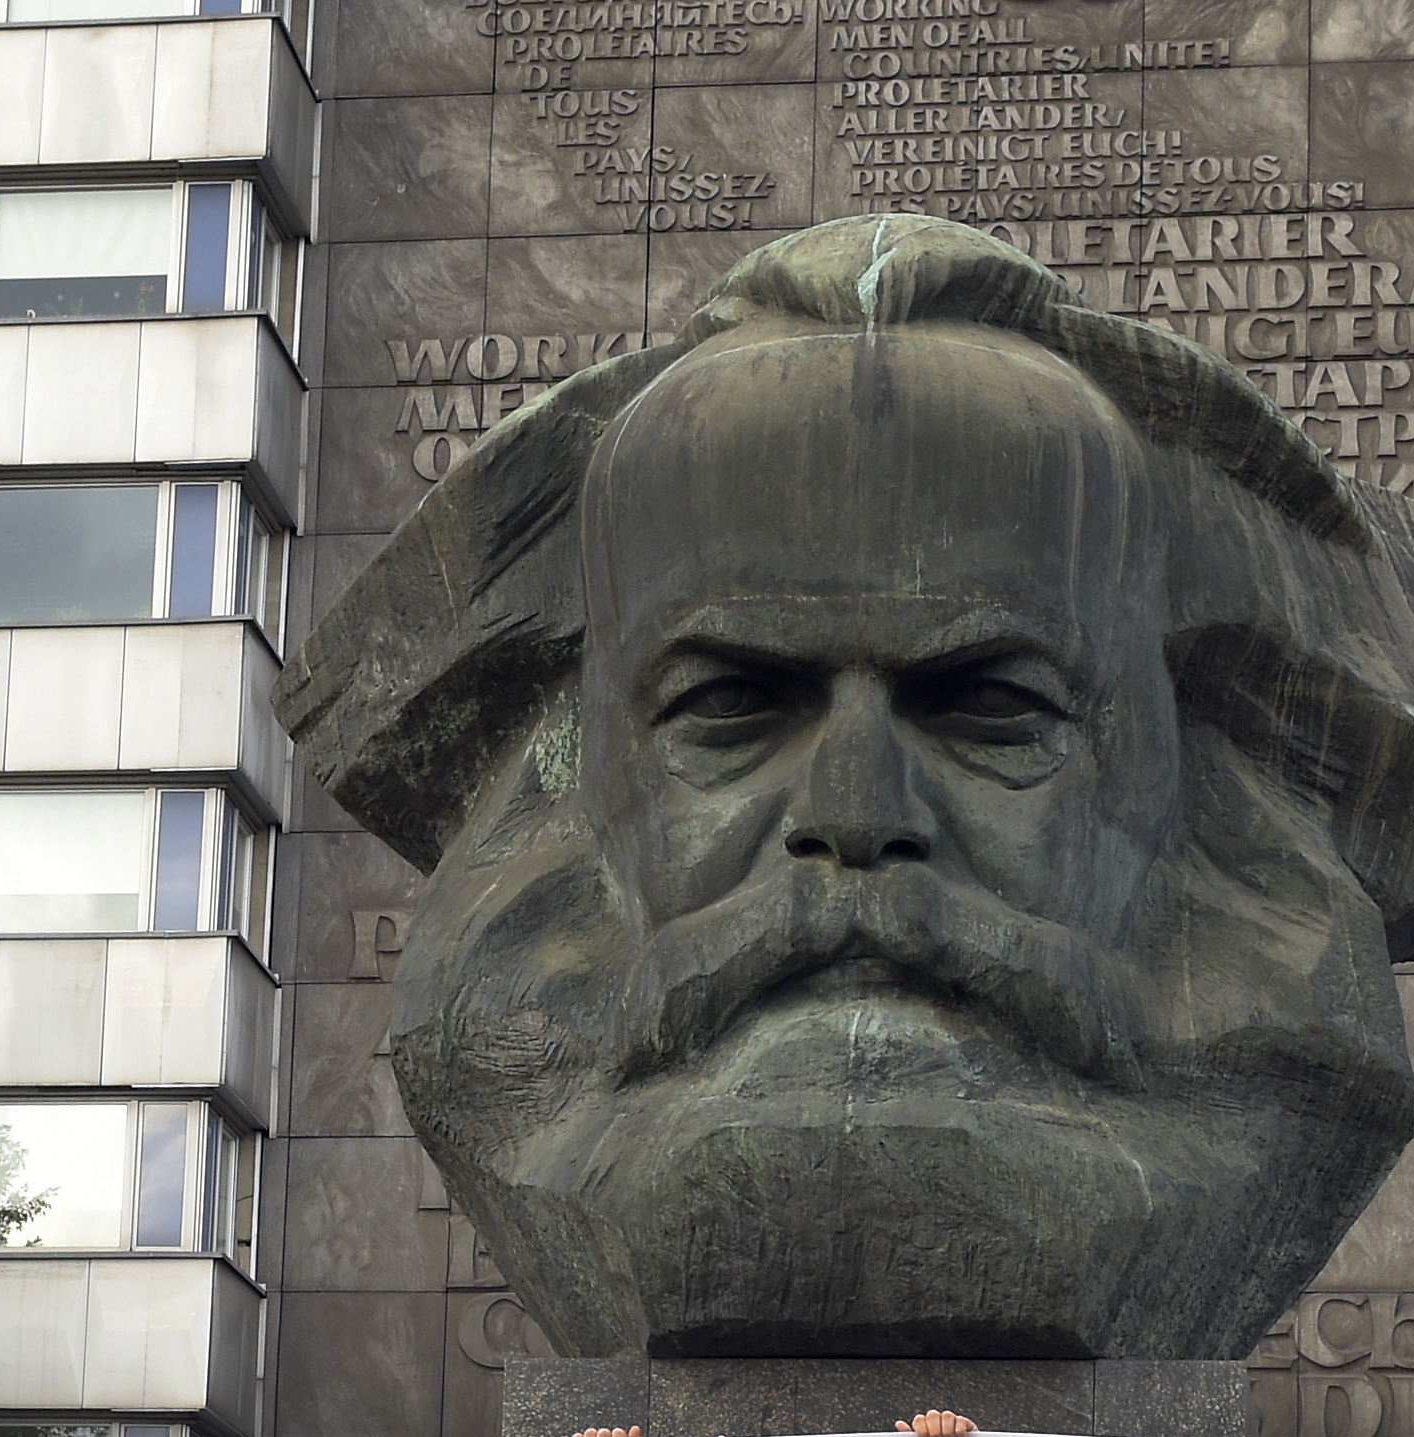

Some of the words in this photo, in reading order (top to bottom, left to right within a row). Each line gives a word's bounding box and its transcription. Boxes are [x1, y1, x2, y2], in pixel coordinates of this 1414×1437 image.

[831, 24, 915, 50] MEN
[922, 21, 969, 47] OF
[967, 18, 1034, 46] ALL
[1090, 38, 1233, 70] UNITE!
[522, 65, 573, 92] DE
[832, 73, 1092, 108] PROLETARIER
[529, 88, 640, 119] TOUS
[555, 119, 621, 148] LES
[836, 107, 950, 137] ALLER
[1060, 129, 1183, 160] EUCH!
[1112, 158, 1163, 188] DE
[1164, 154, 1282, 186] TOUS
[615, 202, 754, 234] VOUS!
